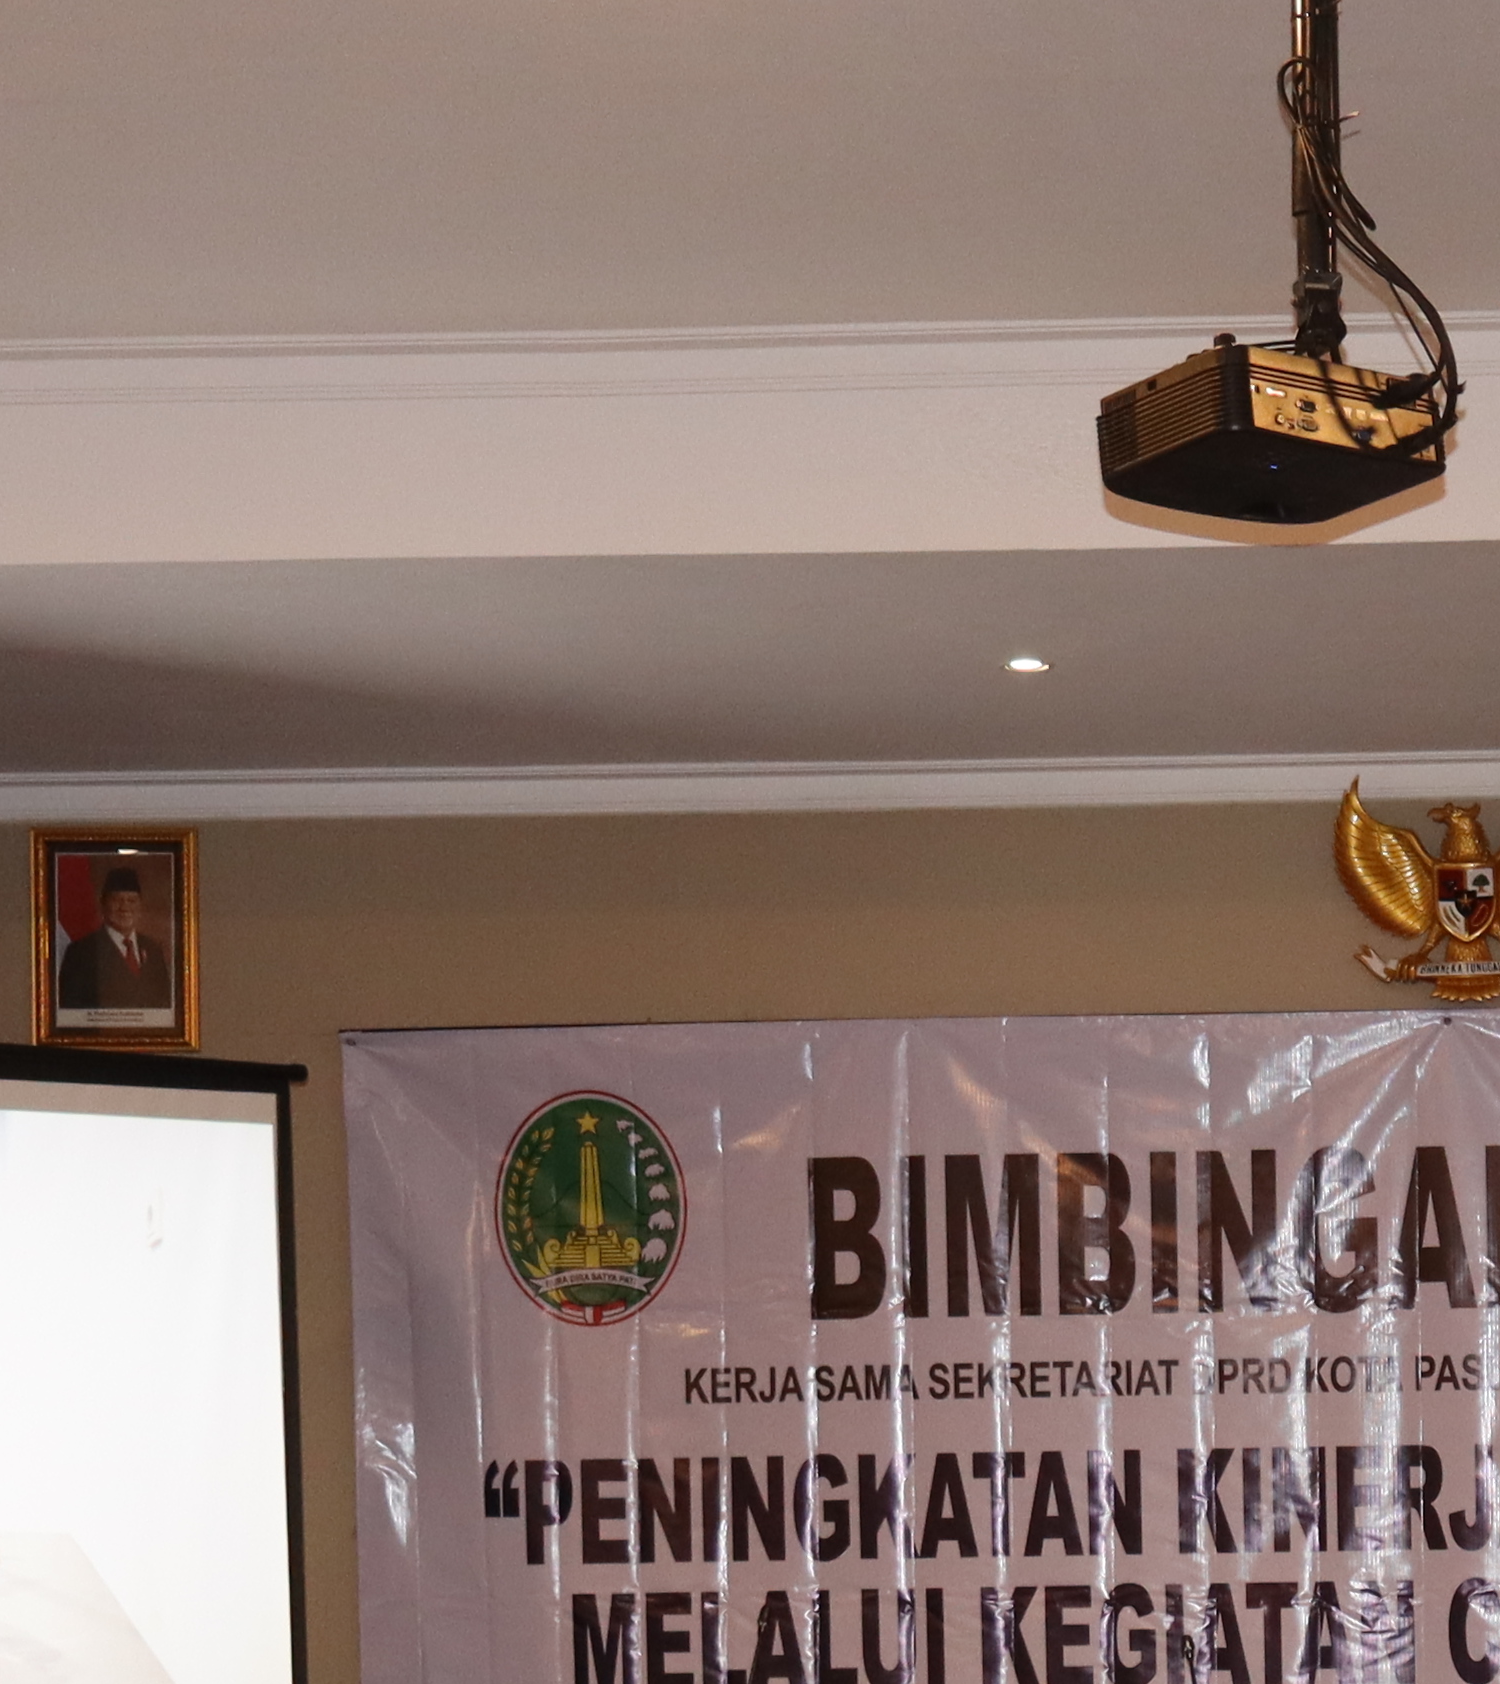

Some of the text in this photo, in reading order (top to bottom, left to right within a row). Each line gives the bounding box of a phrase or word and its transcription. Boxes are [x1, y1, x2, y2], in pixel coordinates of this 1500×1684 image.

[684, 1366, 804, 1405] KERJA
[816, 1363, 920, 1401] SAMA
[929, 1359, 1180, 1400] SEKRETARIAT
[1305, 1354, 1404, 1394] KOTA
[484, 1448, 1143, 1565] “PENINGKATAN
